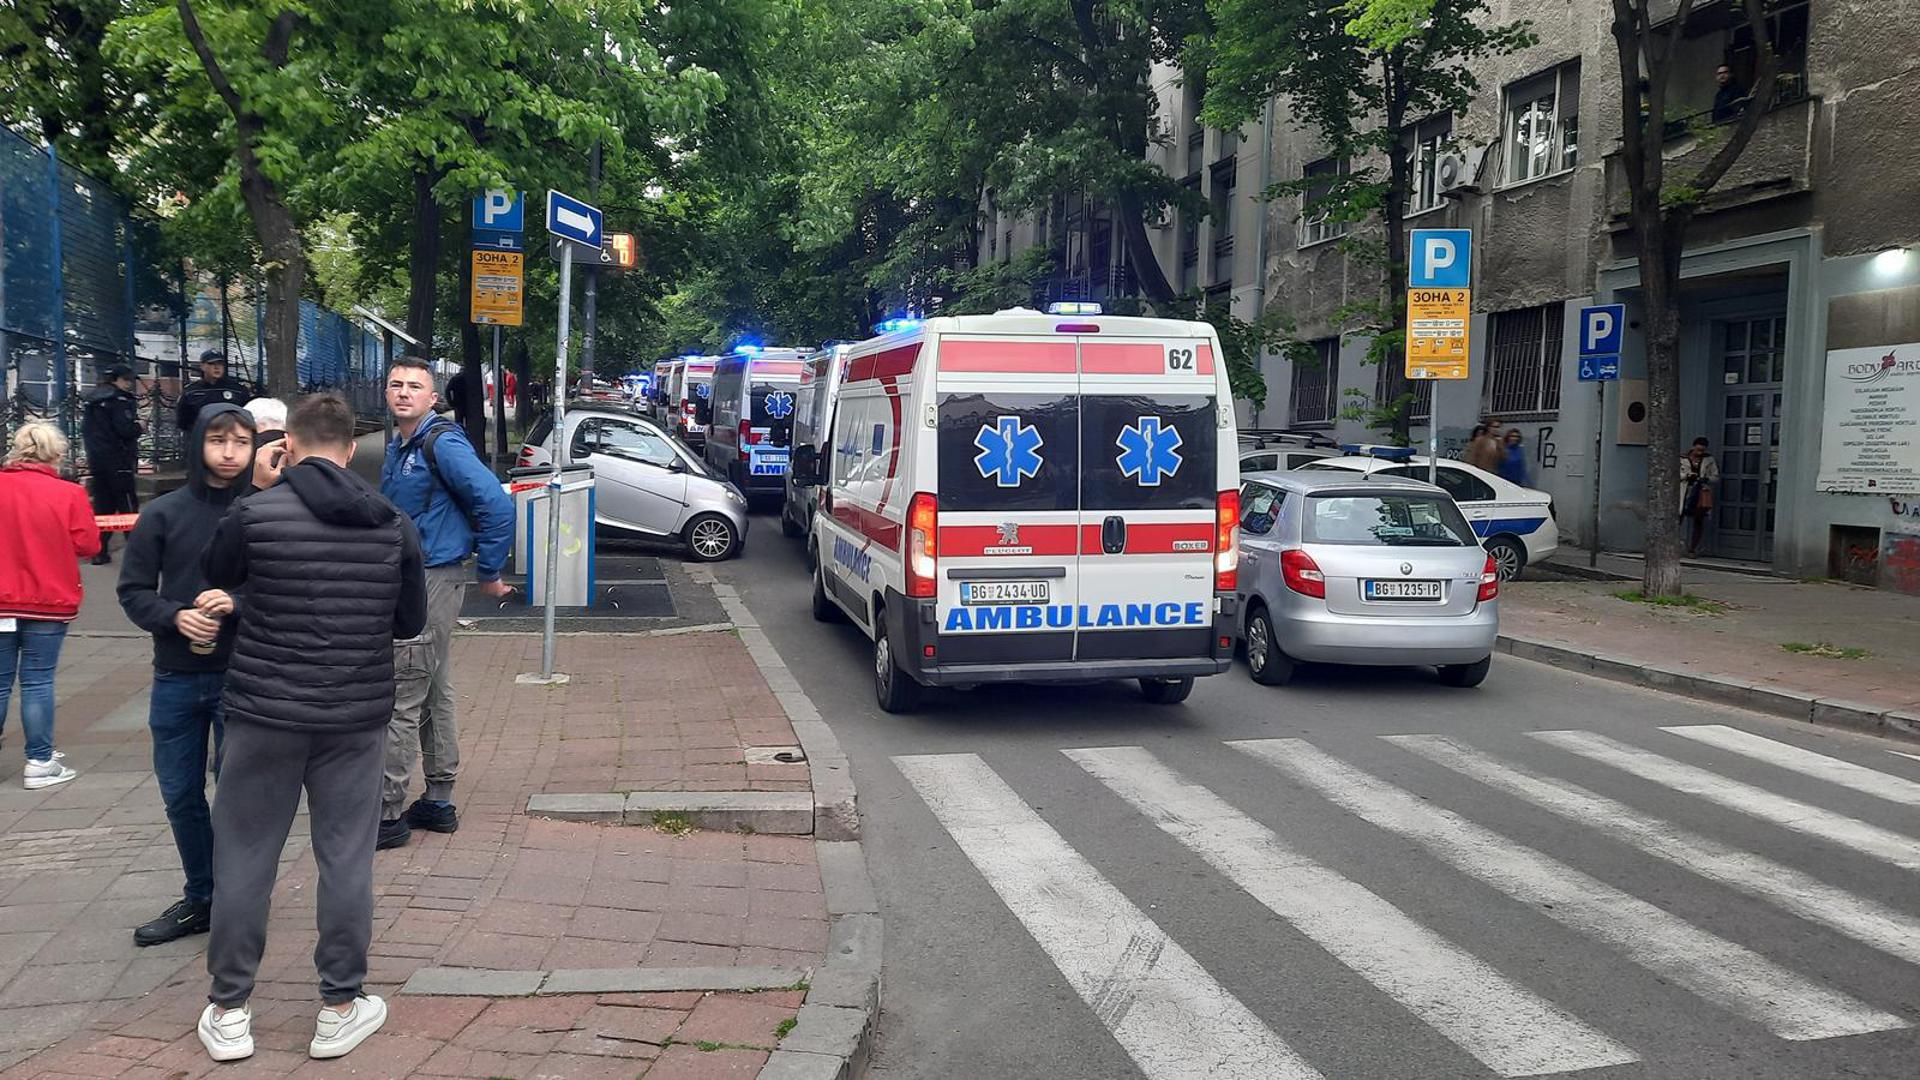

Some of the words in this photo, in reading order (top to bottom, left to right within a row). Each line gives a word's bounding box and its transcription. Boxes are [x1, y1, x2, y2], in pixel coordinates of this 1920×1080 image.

[484, 187, 512, 224] P
[476, 252, 507, 263] ЗОНА
[512, 256, 519, 264] 2
[1424, 238, 1456, 279] P
[1413, 292, 1450, 303] ЗОНА
[1457, 292, 1465, 302] 2
[1588, 311, 1613, 350] P
[1168, 348, 1193, 370] 62
[1174, 541, 1207, 550] BOXER
[971, 584, 987, 599] BG
[1375, 582, 1389, 595] BG
[944, 601, 1204, 632] AMBULANCE
